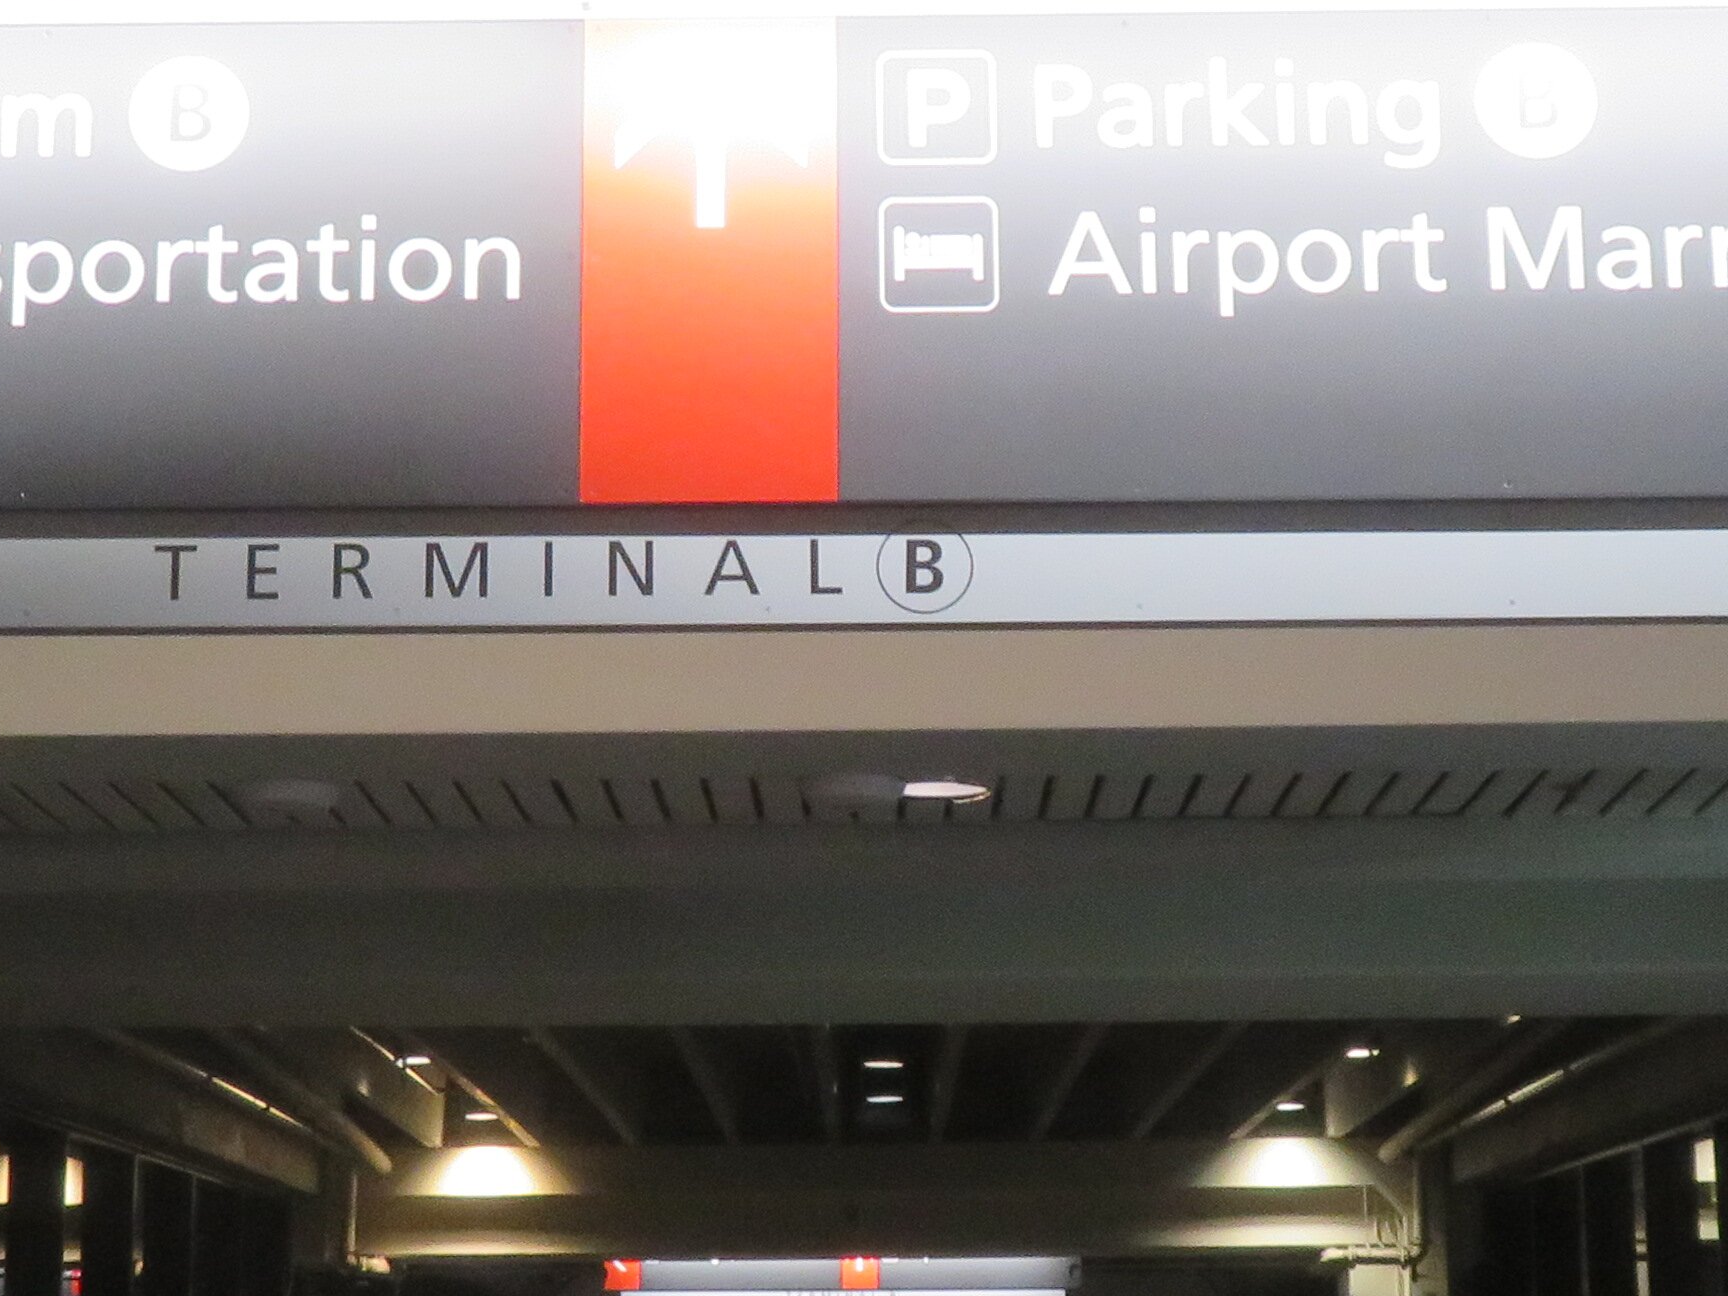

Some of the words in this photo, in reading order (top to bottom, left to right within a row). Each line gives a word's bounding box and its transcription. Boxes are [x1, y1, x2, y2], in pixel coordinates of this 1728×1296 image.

[1031, 55, 1442, 170] Parking
[1047, 204, 1447, 318] Airport
[154, 538, 844, 601] TERMINAL
[904, 538, 945, 596] B
